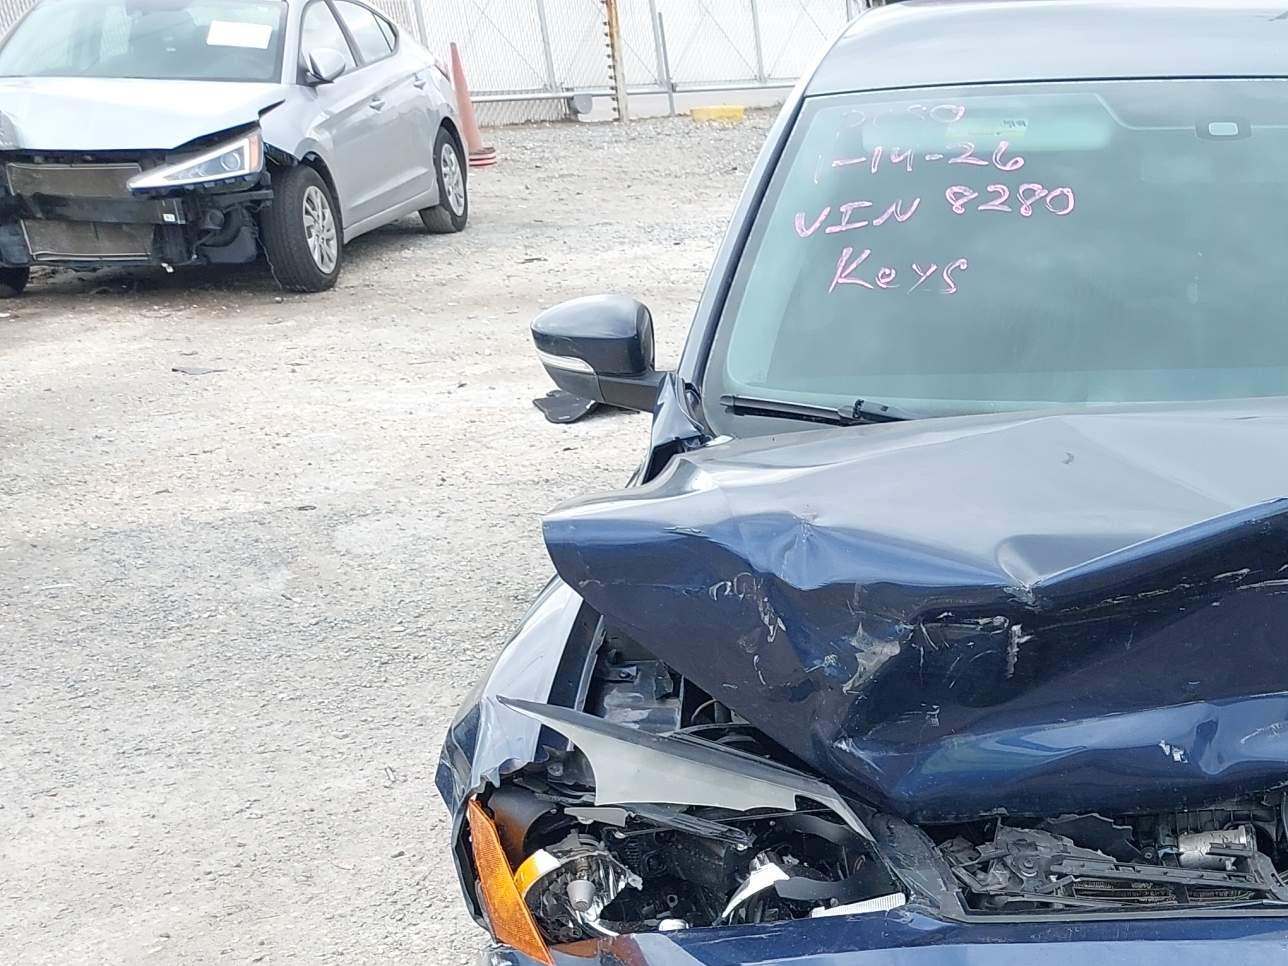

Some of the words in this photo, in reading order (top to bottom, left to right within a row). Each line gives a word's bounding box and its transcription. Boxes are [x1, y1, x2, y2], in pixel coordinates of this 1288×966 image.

[793, 197, 921, 238] VIN
[945, 183, 1075, 217] 8280
[828, 247, 968, 295] Keys
